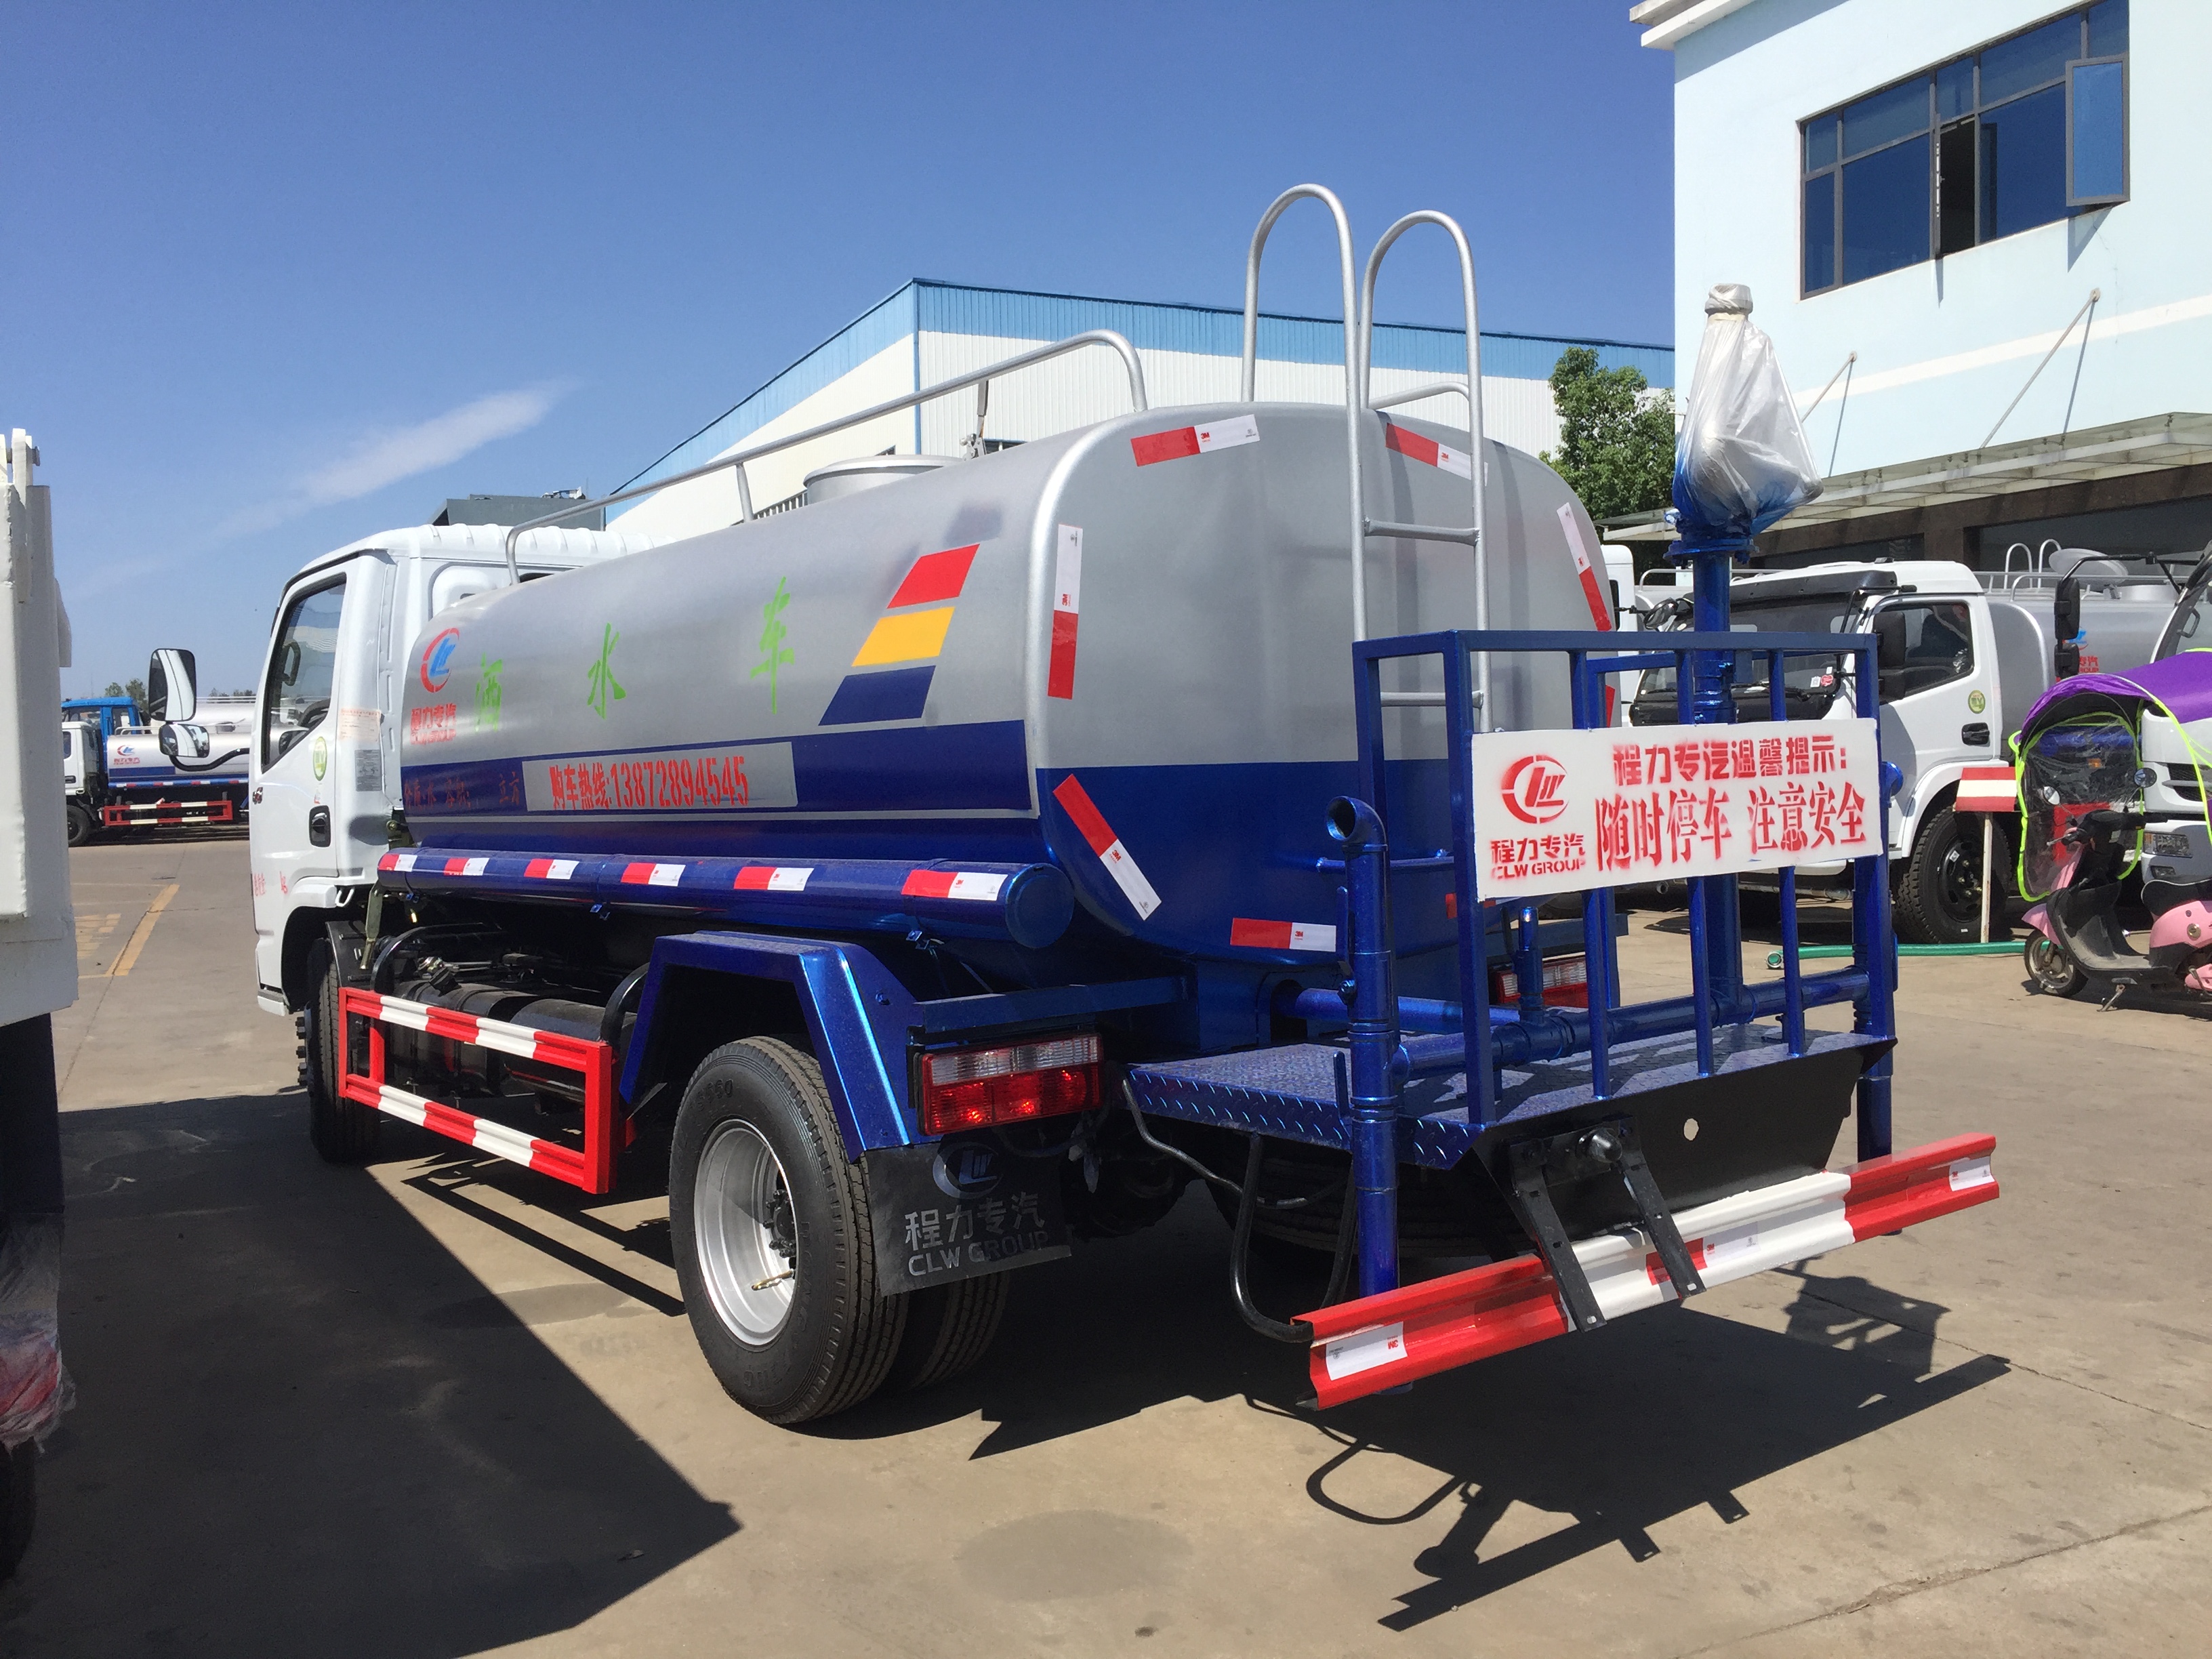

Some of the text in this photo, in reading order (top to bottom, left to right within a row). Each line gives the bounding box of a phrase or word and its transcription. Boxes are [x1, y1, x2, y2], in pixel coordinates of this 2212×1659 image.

[1490, 833, 1586, 864] 程力专汽
[1595, 781, 1866, 872] 随时停车 注意安全
[1490, 859, 1586, 880] CLW GROUP
[905, 1191, 1045, 1251] 程力专汽
[908, 1231, 1048, 1275] CLW GROUP
